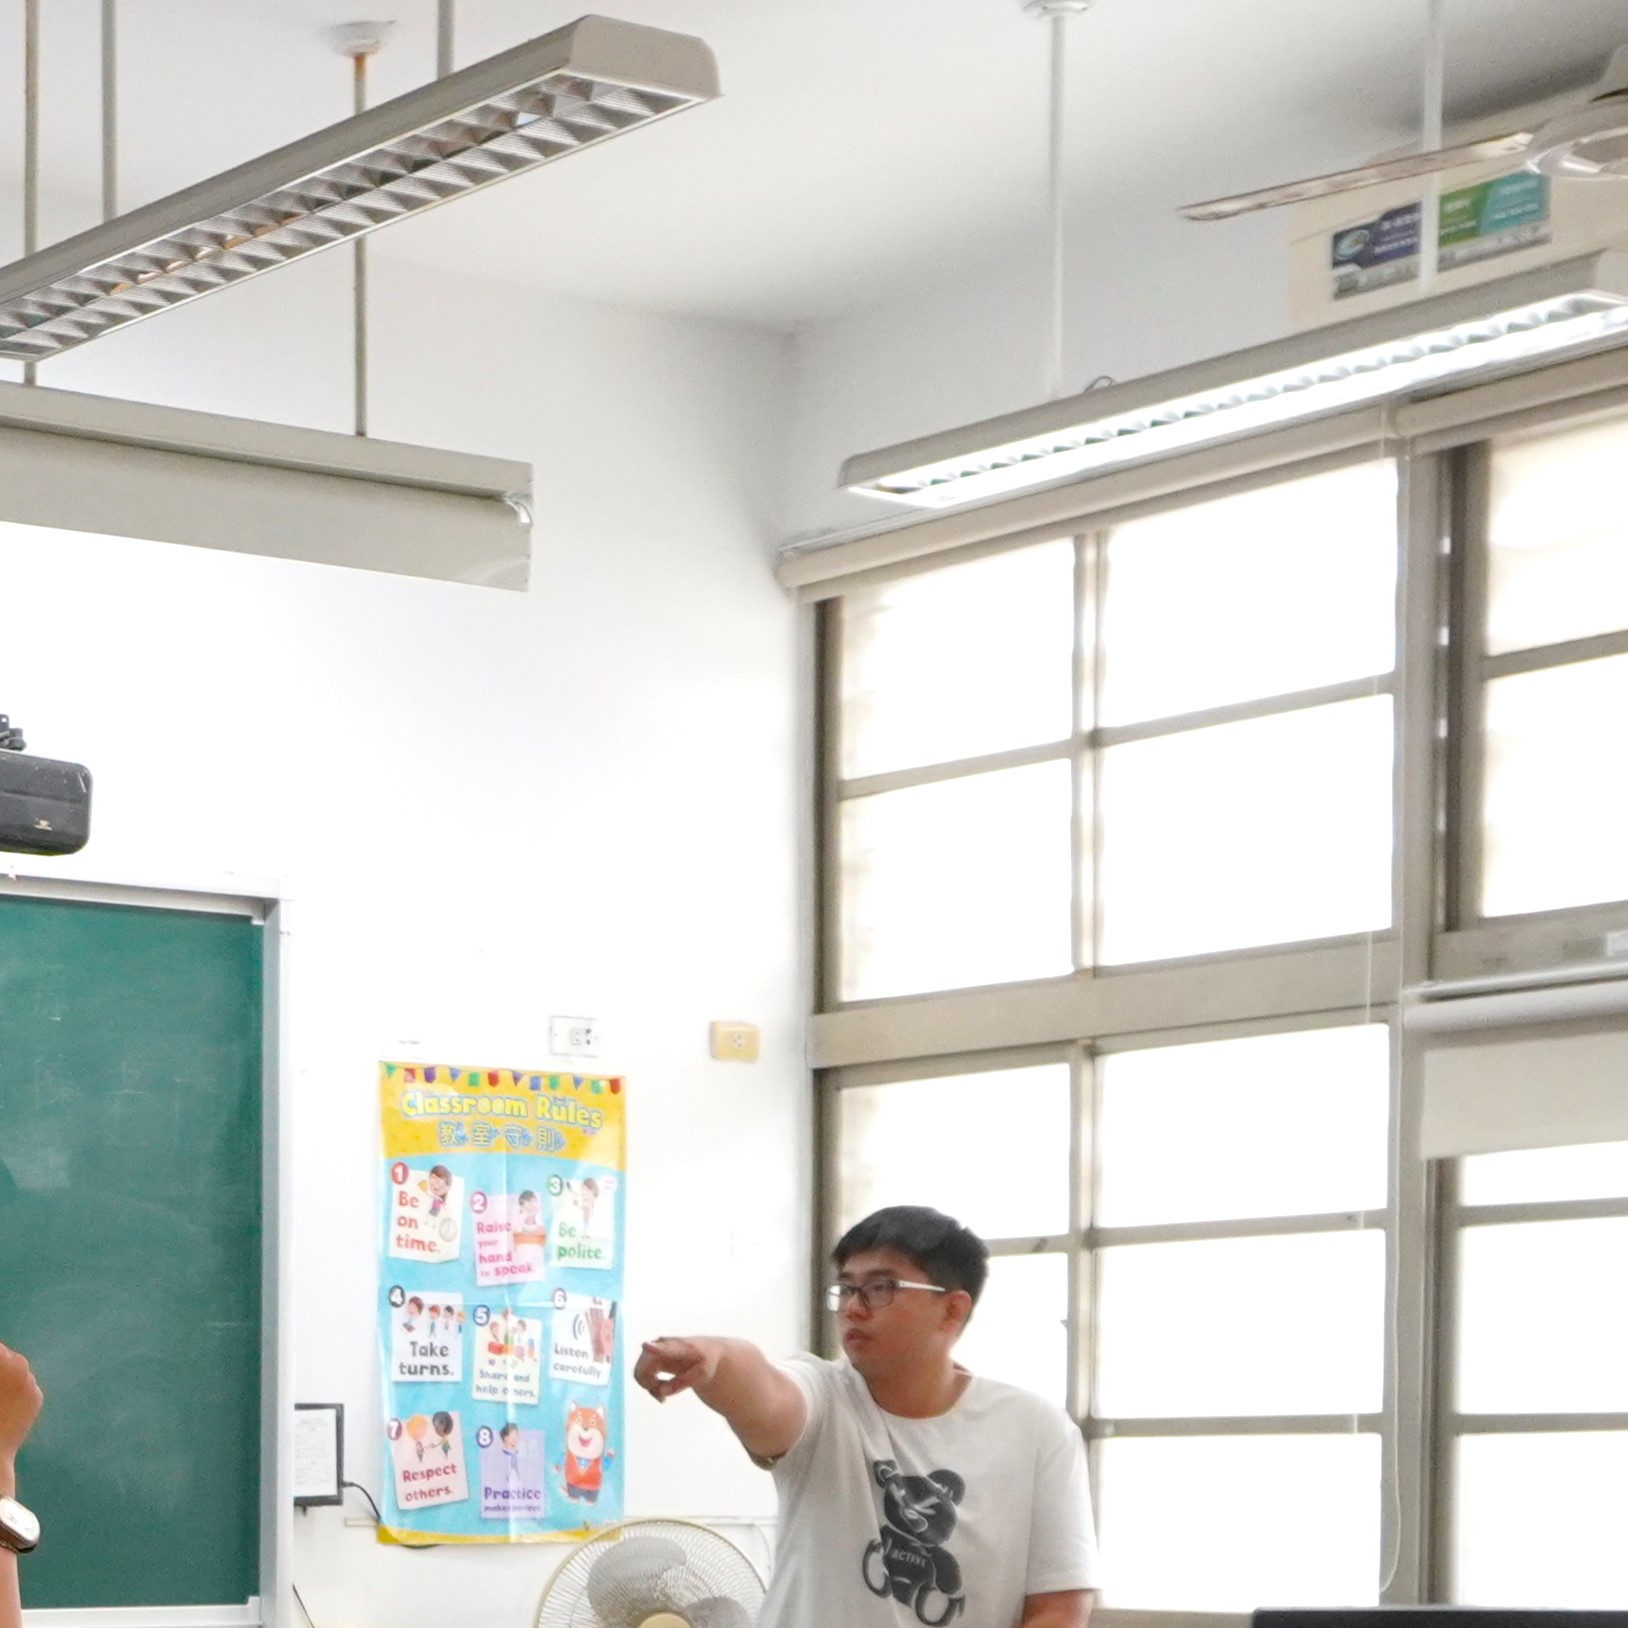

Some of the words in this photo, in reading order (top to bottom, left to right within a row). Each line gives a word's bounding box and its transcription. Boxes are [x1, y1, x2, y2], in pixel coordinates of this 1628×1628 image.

[401, 1091, 529, 1118] Classroom
[536, 1094, 603, 1130] Rules
[438, 1121, 566, 1152] 教室守則
[398, 1191, 419, 1208] Be
[397, 1215, 419, 1229] on
[476, 1221, 512, 1234] Raise
[558, 1222, 577, 1238] Be
[396, 1234, 441, 1253] time.
[479, 1251, 512, 1264] hand
[409, 1341, 449, 1357] Take
[554, 1343, 589, 1359] Listen
[399, 1362, 454, 1376] turns.
[475, 1384, 498, 1396] help
[403, 1463, 457, 1483] Respect
[405, 1485, 454, 1502] others.
[484, 1486, 542, 1500] Practice
[891, 1549, 927, 1569] ACTIVE
